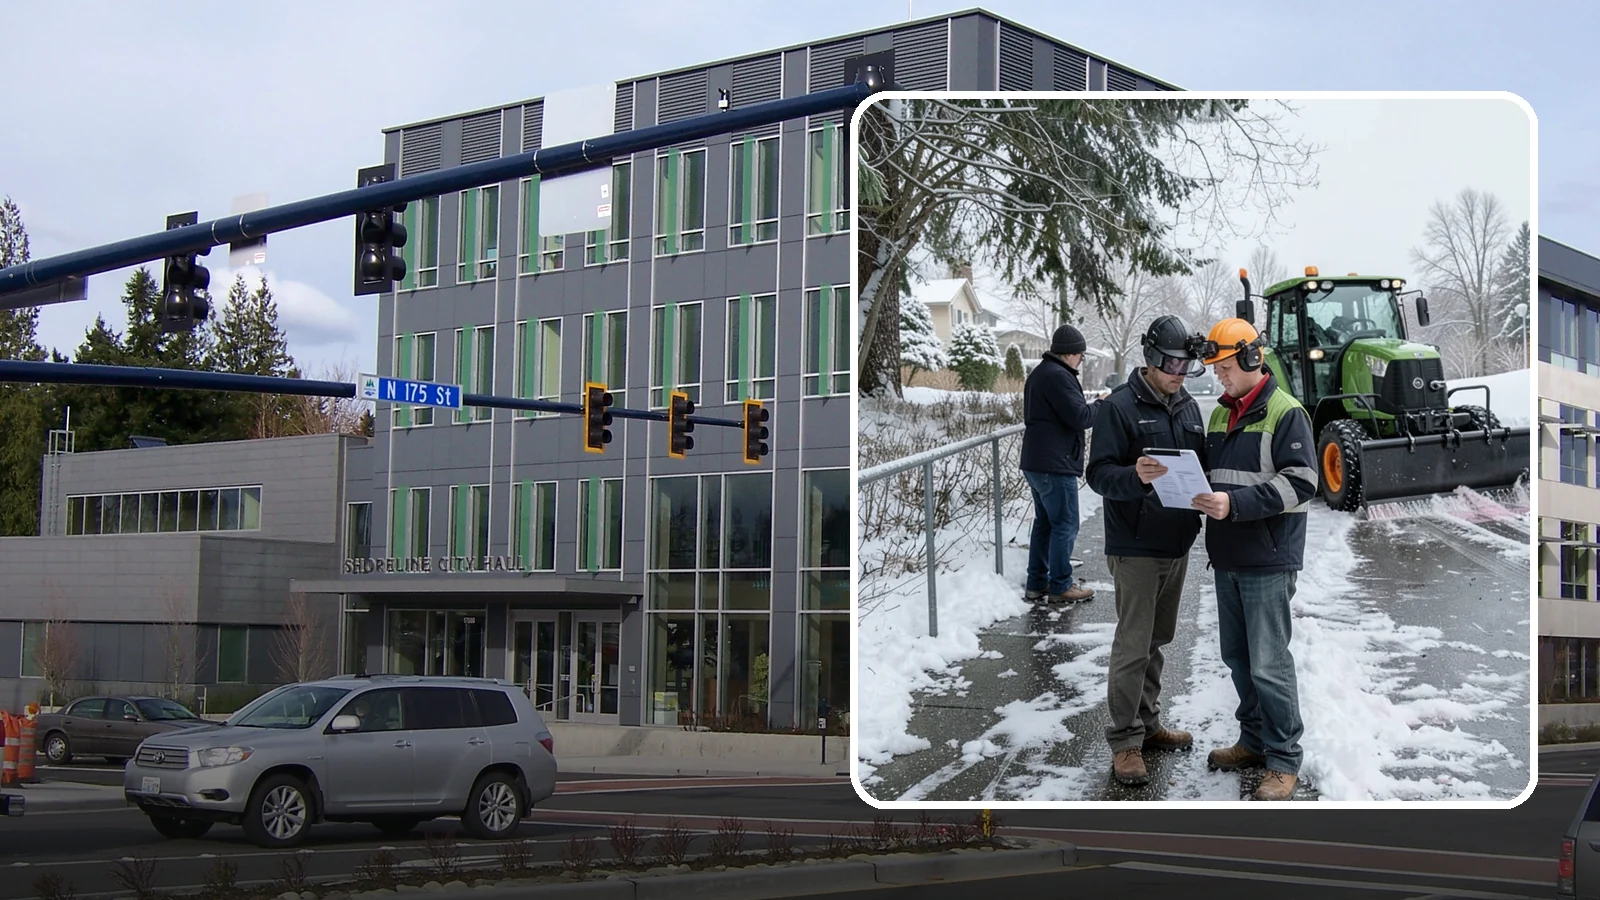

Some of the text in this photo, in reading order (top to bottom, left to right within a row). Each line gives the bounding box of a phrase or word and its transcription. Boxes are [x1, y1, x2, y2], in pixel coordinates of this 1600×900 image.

[387, 380, 452, 406] N 175 St
[343, 555, 525, 574] SHORELINE CITY HALL
